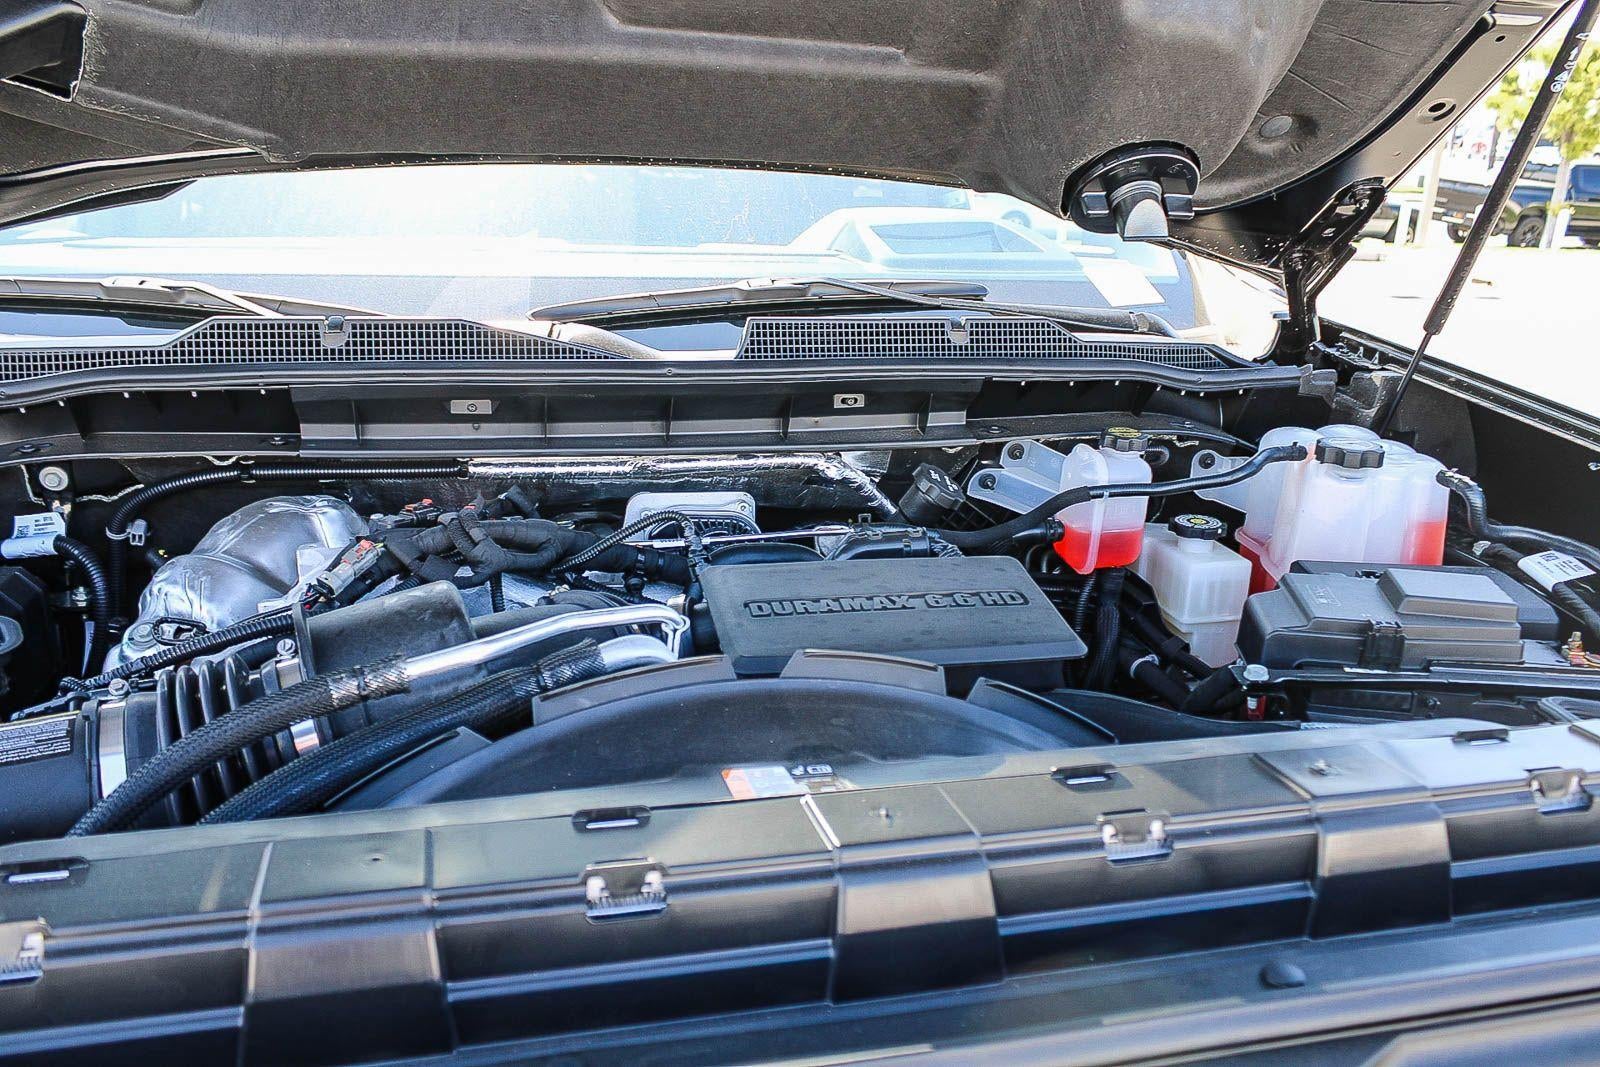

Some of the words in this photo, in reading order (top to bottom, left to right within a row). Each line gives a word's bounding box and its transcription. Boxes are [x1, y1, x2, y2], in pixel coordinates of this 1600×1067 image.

[748, 594, 913, 617] DURAMAX
[924, 592, 976, 609] 6.6
[979, 591, 1026, 607] HD
